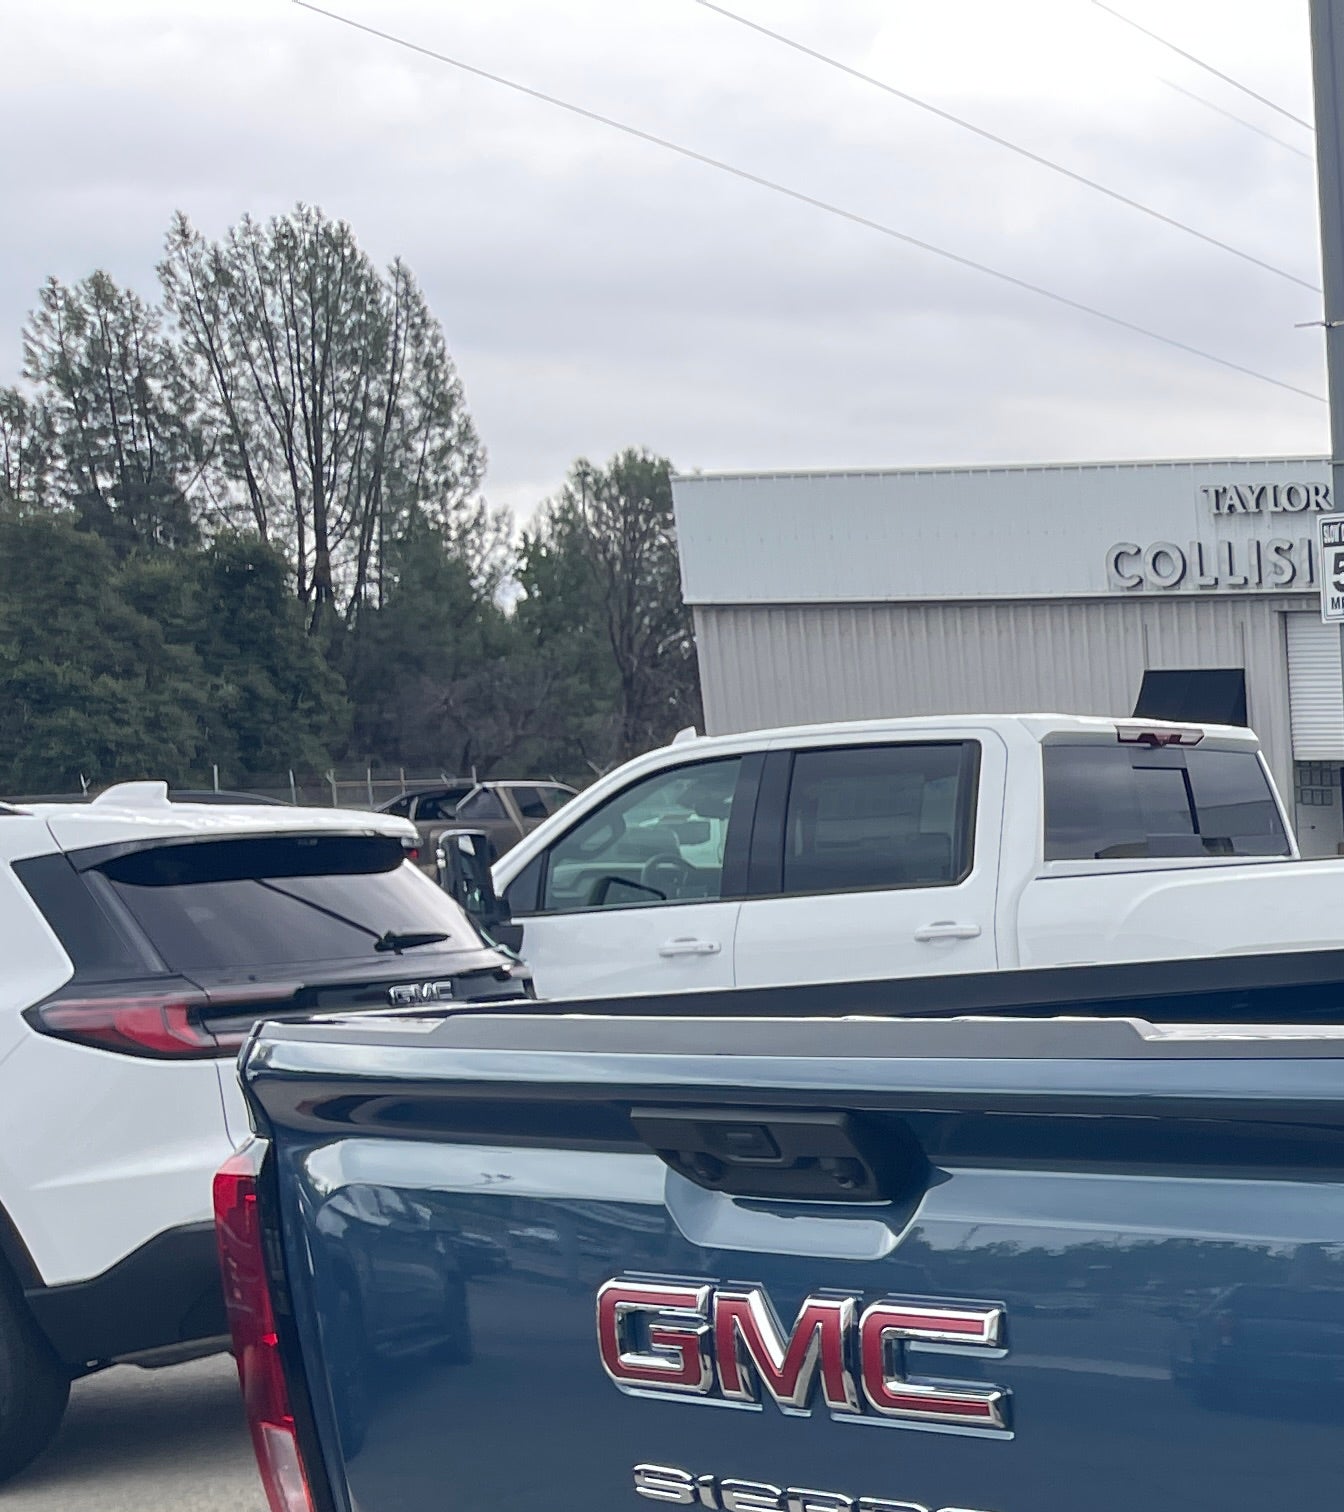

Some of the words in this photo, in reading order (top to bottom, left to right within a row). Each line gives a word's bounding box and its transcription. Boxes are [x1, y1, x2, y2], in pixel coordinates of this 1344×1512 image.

[1201, 481, 1335, 515] TAYLOR
[1105, 537, 1315, 588] COLLISI
[596, 1275, 1012, 1430] GMC
